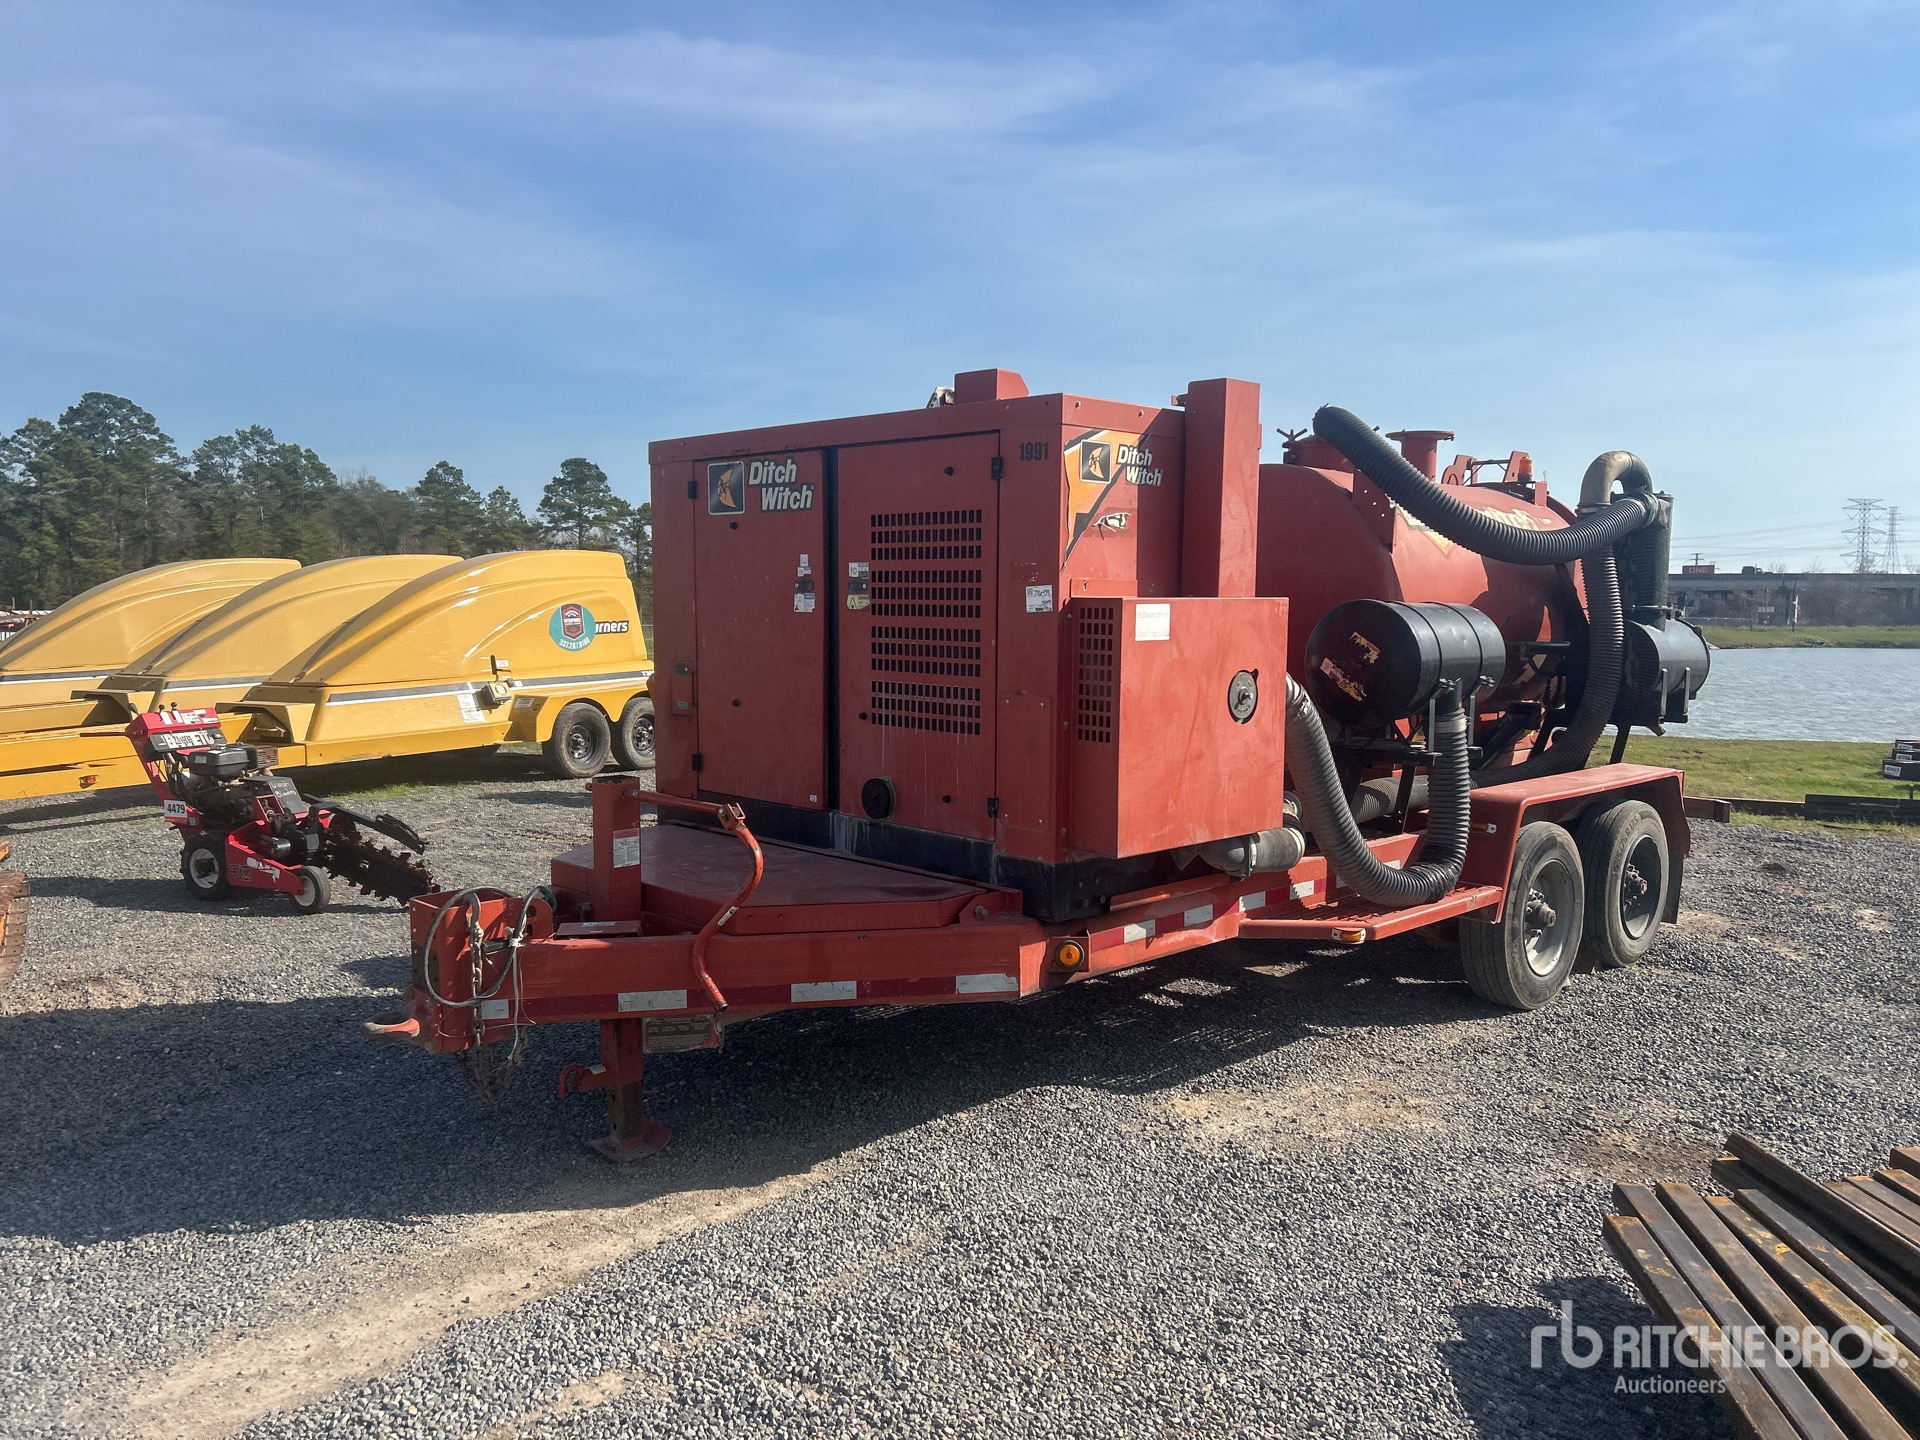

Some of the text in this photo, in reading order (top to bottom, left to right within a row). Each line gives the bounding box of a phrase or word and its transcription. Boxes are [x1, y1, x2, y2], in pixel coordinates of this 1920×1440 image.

[1018, 441, 1049, 461] 1991
[1117, 444, 1153, 466] Ditch
[748, 458, 797, 485] Ditch
[1126, 465, 1162, 487] Witch
[761, 484, 814, 511] Witch
[166, 803, 186, 815] 4479
